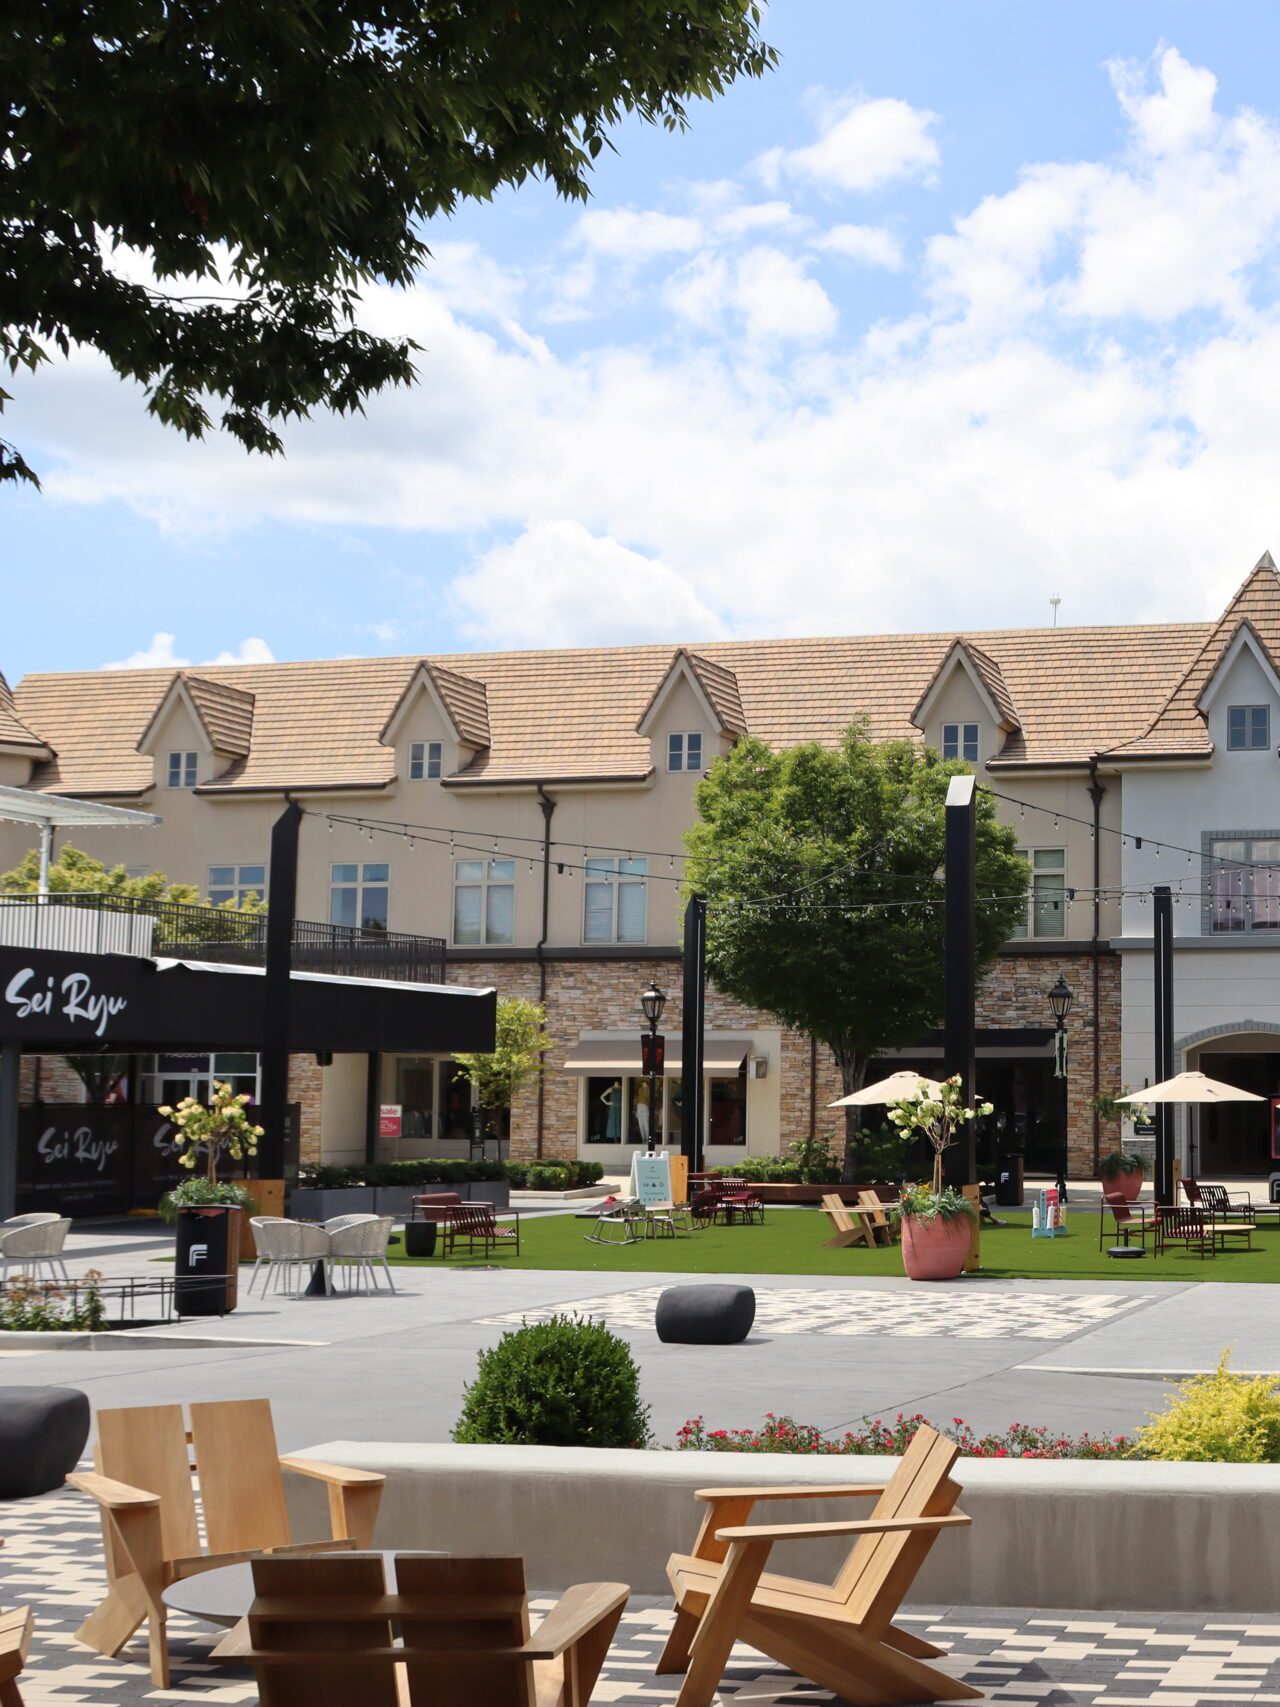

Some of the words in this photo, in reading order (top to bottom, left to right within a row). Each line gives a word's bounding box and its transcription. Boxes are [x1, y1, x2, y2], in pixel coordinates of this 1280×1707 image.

[5, 968, 54, 1018] Sei
[61, 972, 127, 1037] Ryu
[37, 1126, 69, 1164] Sei
[74, 1126, 119, 1172] Ryu
